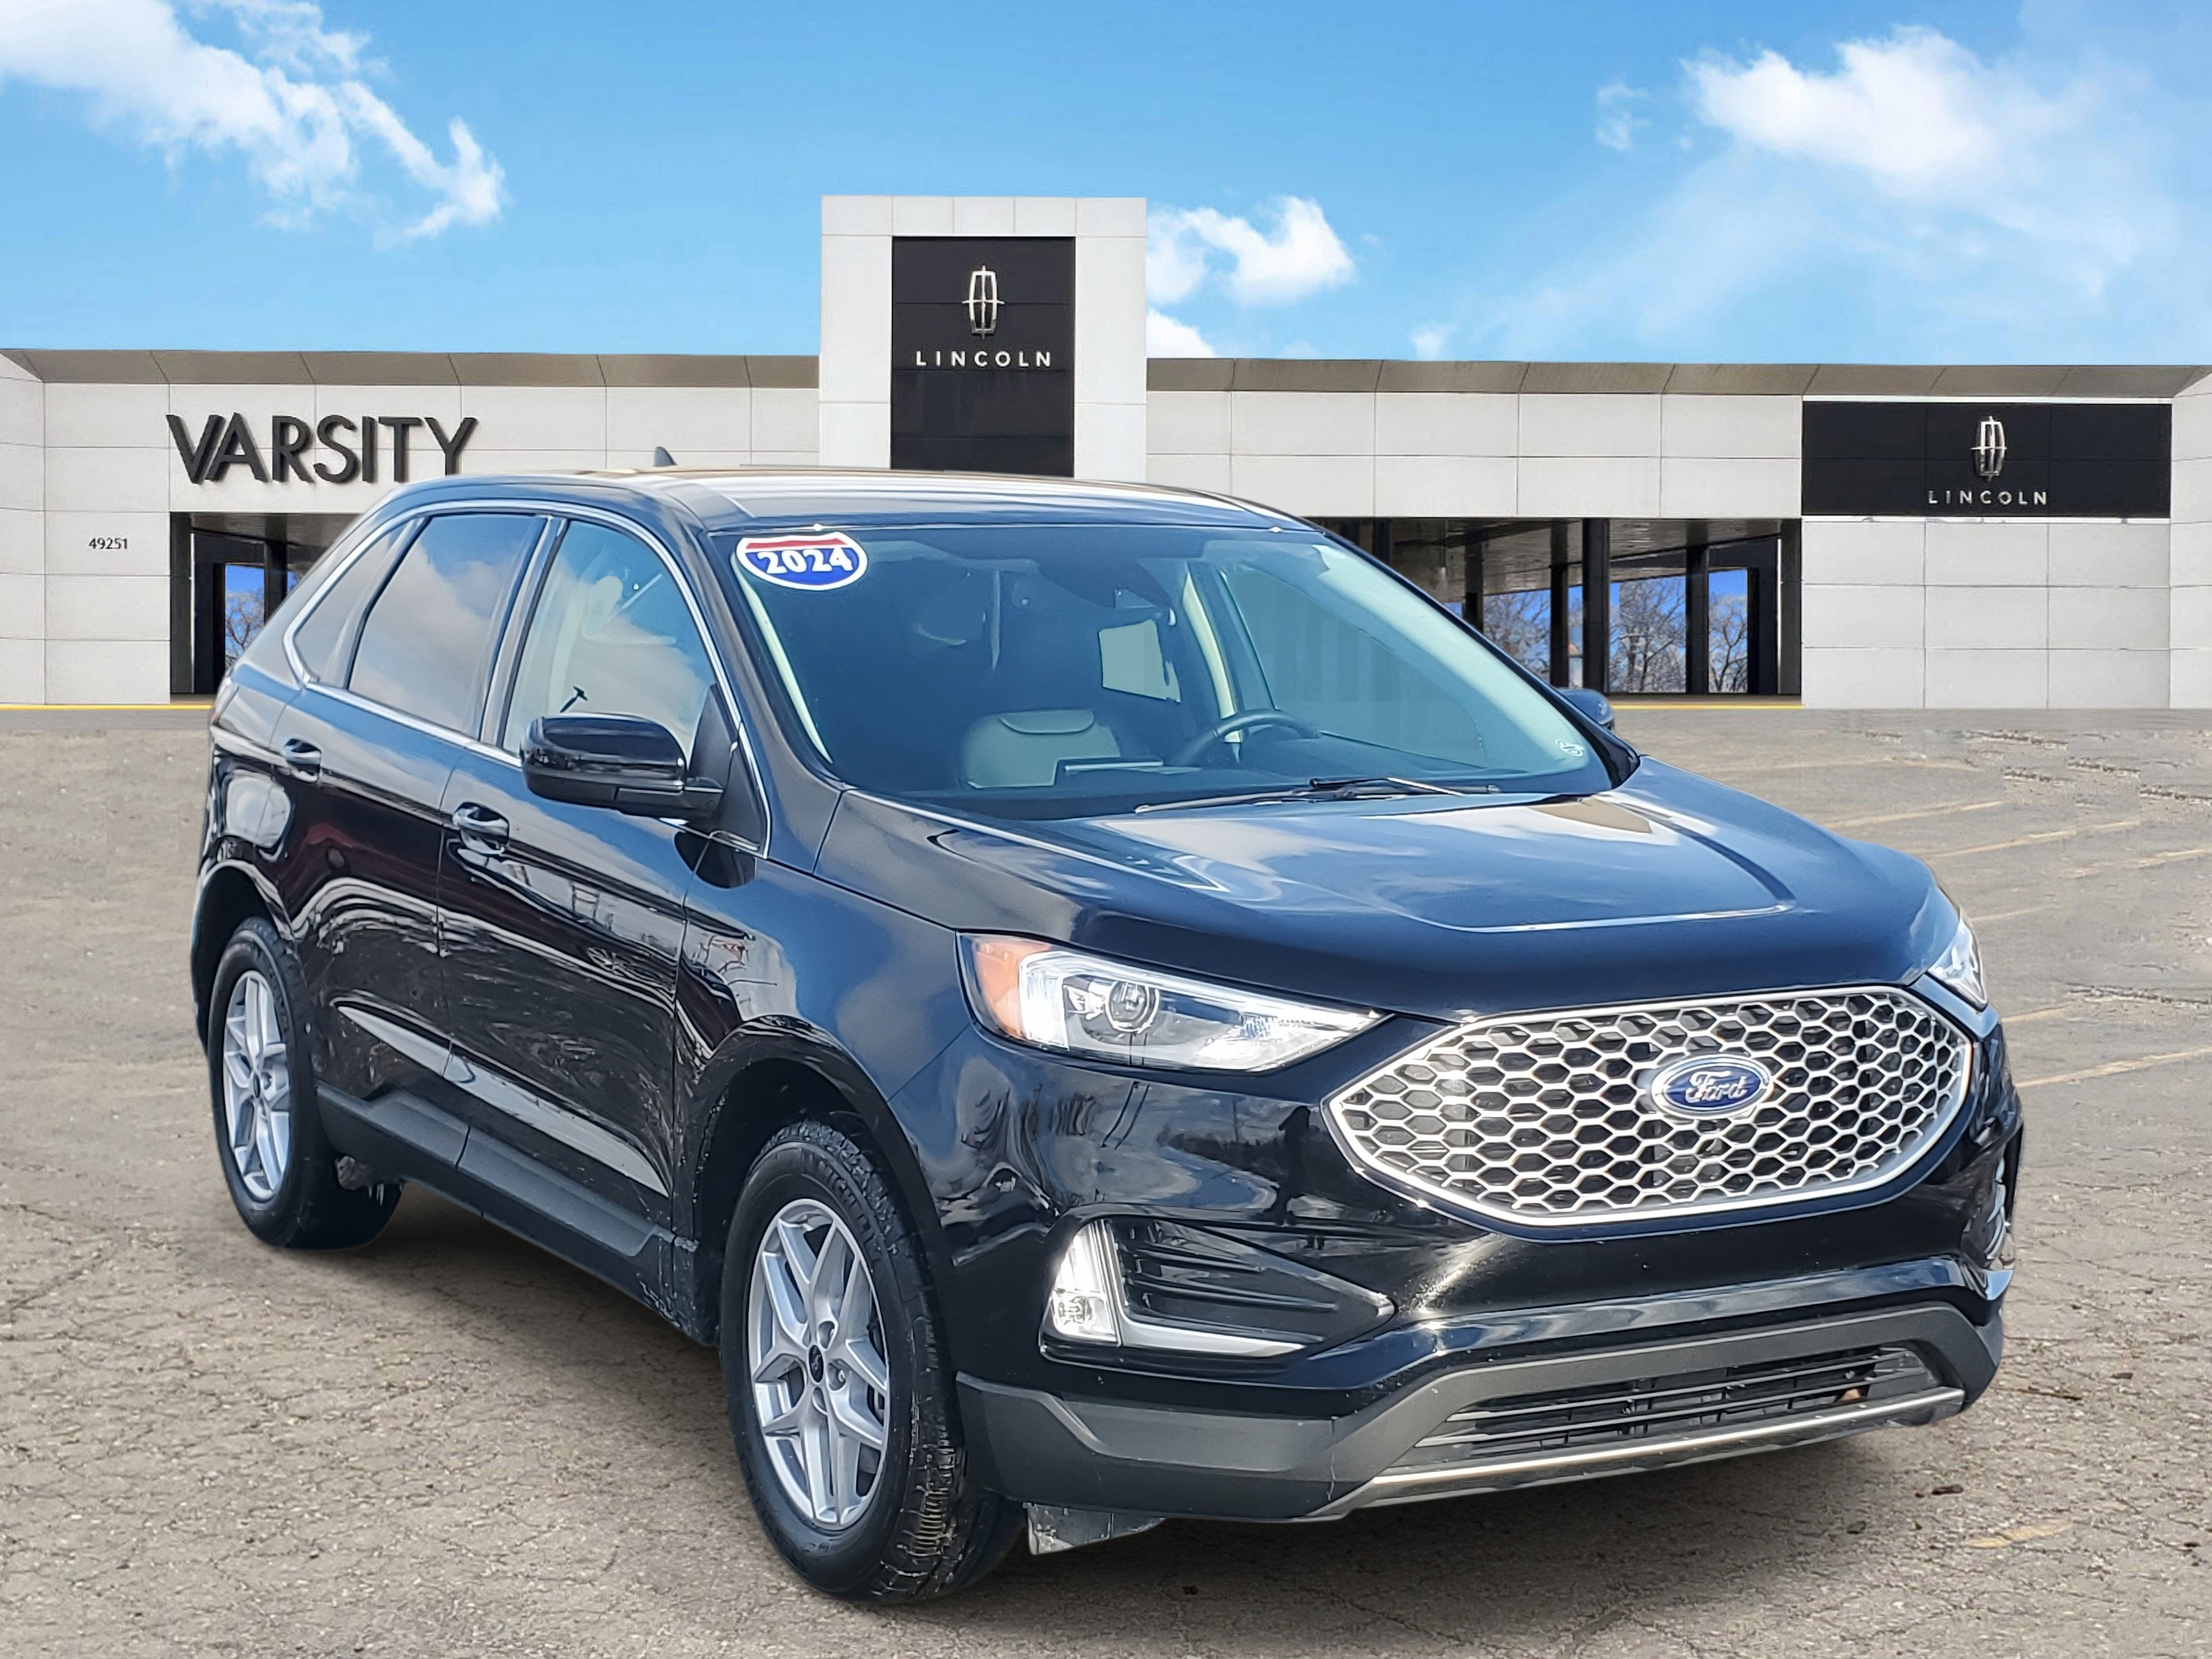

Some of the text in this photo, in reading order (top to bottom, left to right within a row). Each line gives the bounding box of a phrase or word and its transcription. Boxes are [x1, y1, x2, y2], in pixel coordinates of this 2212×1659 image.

[916, 351, 1051, 367] LINCOLN
[166, 412, 479, 484] VARSITY
[1928, 491, 2047, 505] LINCOLN
[89, 538, 128, 550] 49251
[757, 548, 853, 574] 2024
[1685, 1070, 1748, 1103] Ford
